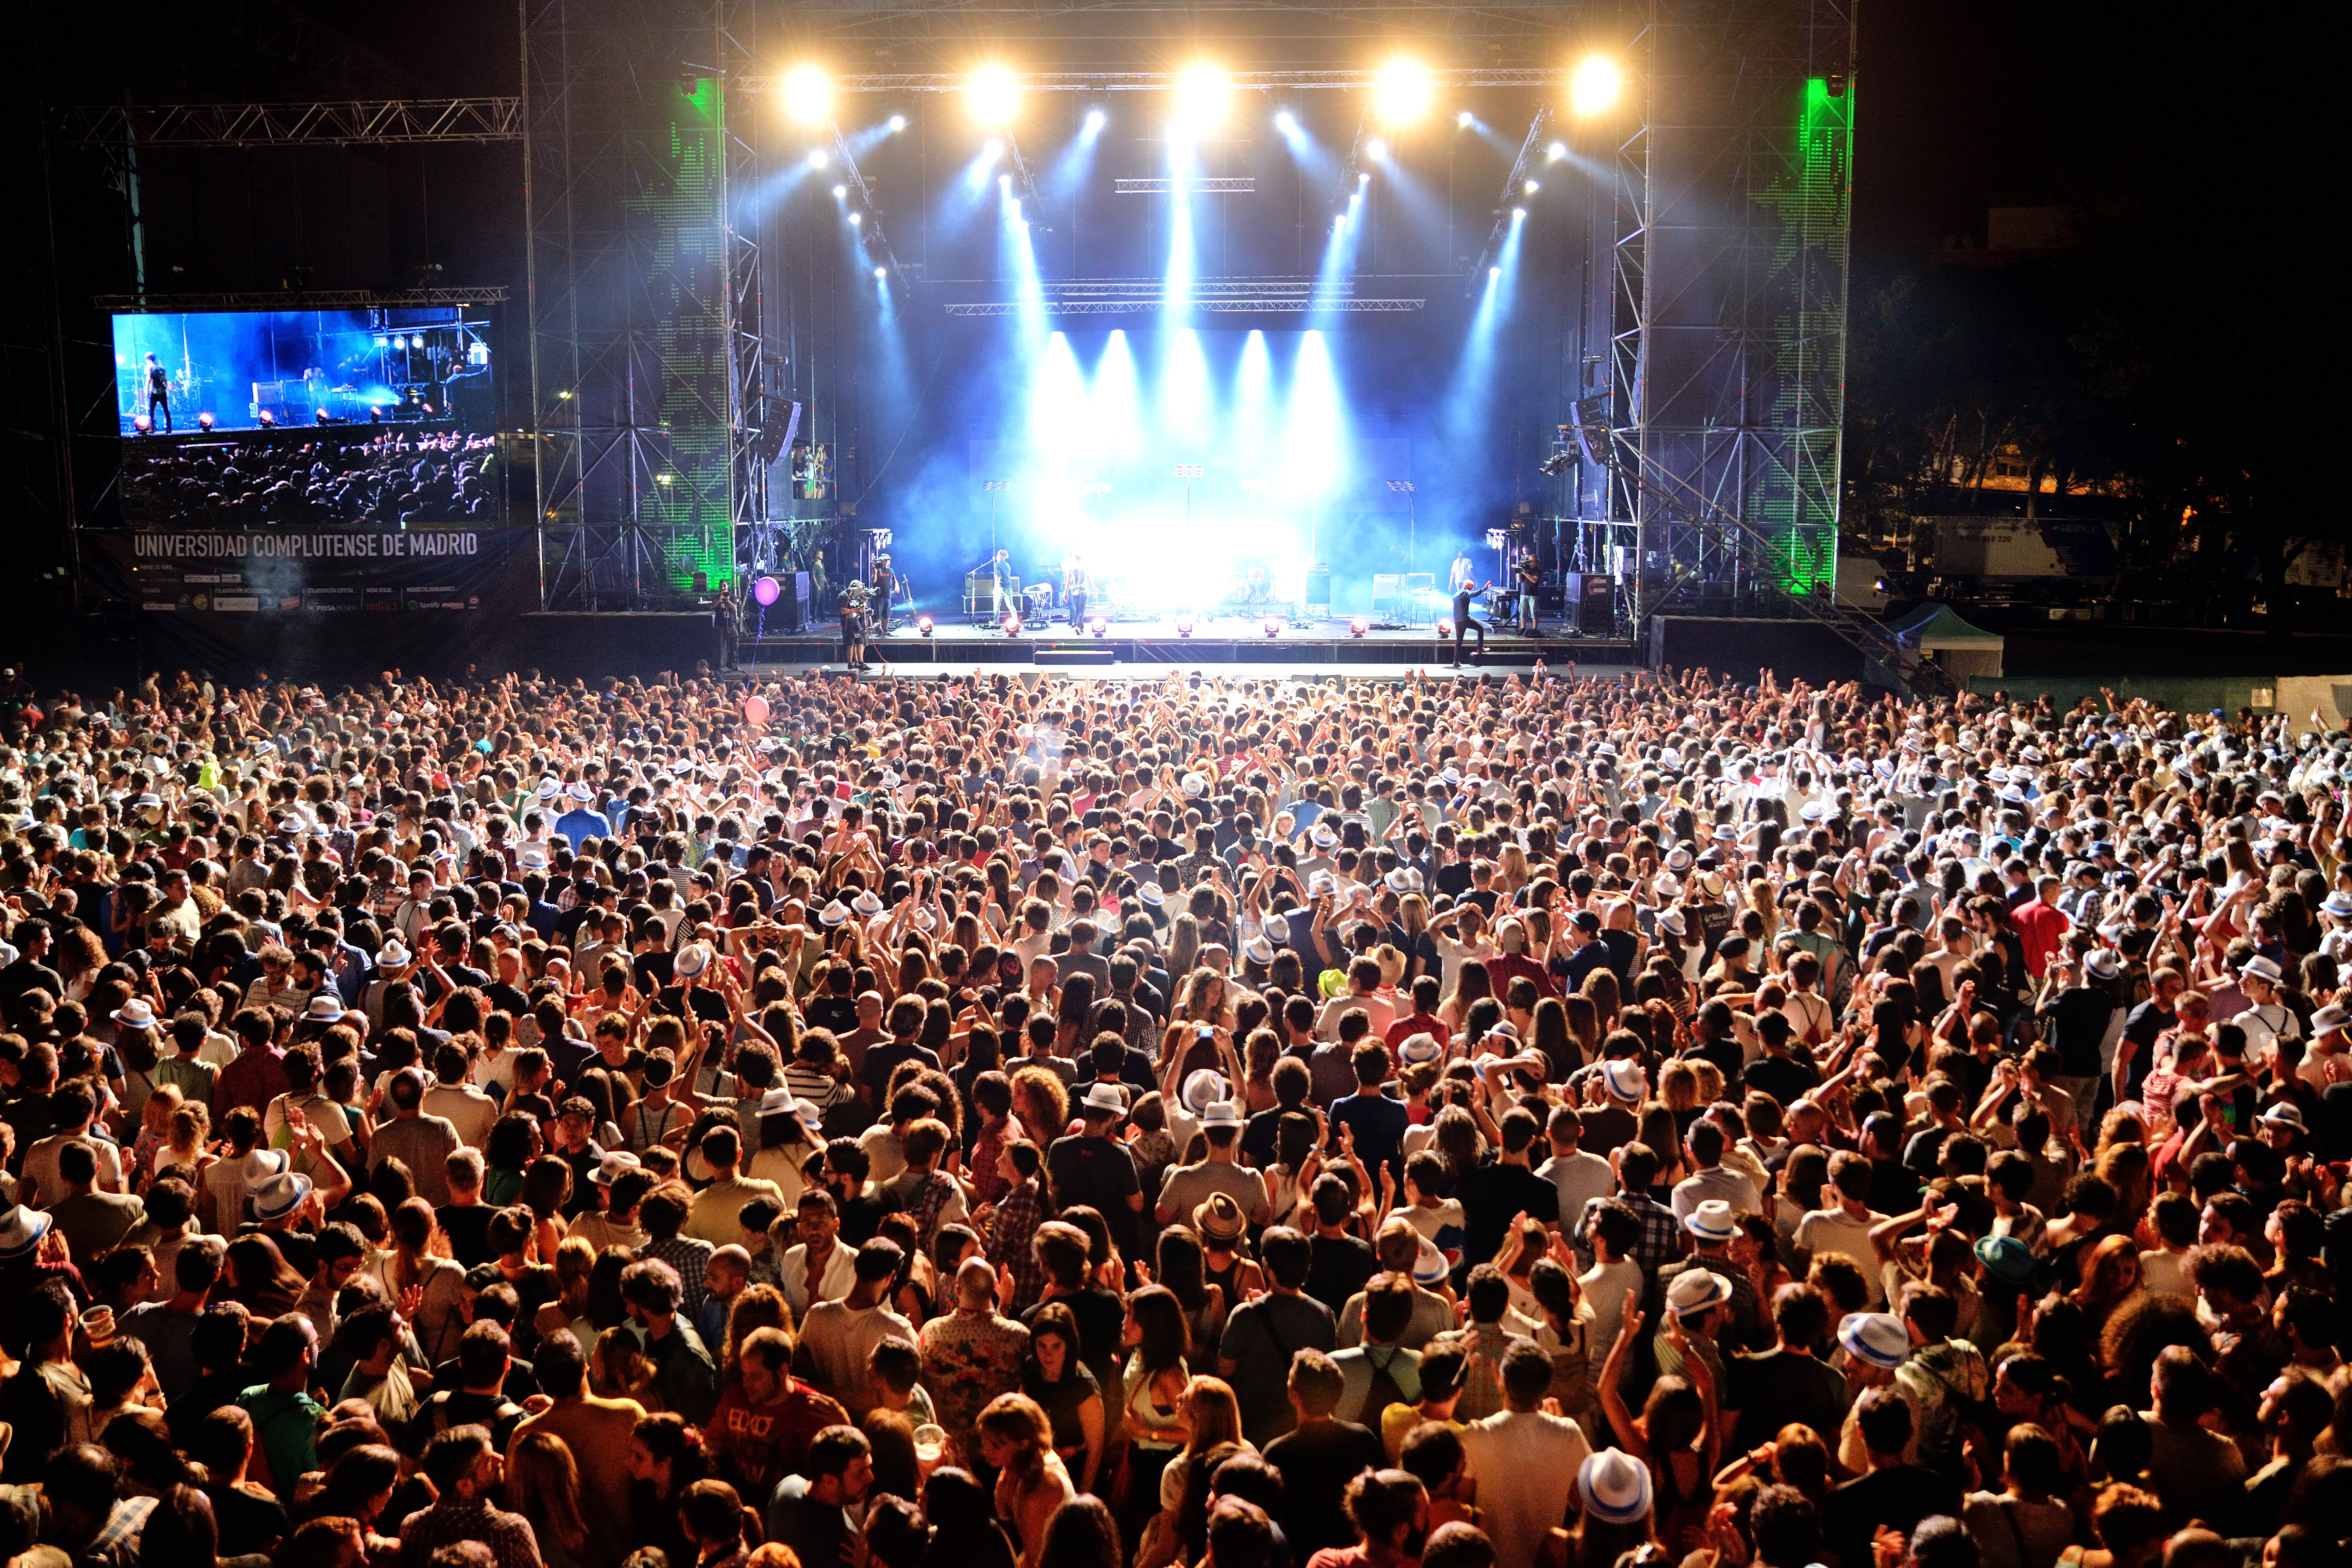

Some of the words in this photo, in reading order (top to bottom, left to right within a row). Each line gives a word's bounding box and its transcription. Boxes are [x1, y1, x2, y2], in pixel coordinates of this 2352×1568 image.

[135, 535, 247, 557] UNIVERSIDAD
[253, 534, 377, 557] COMPLUTENSE
[383, 534, 405, 556] DE
[410, 533, 477, 555] MADRID
[365, 601, 390, 611] radio
[392, 602, 397, 610] 3
